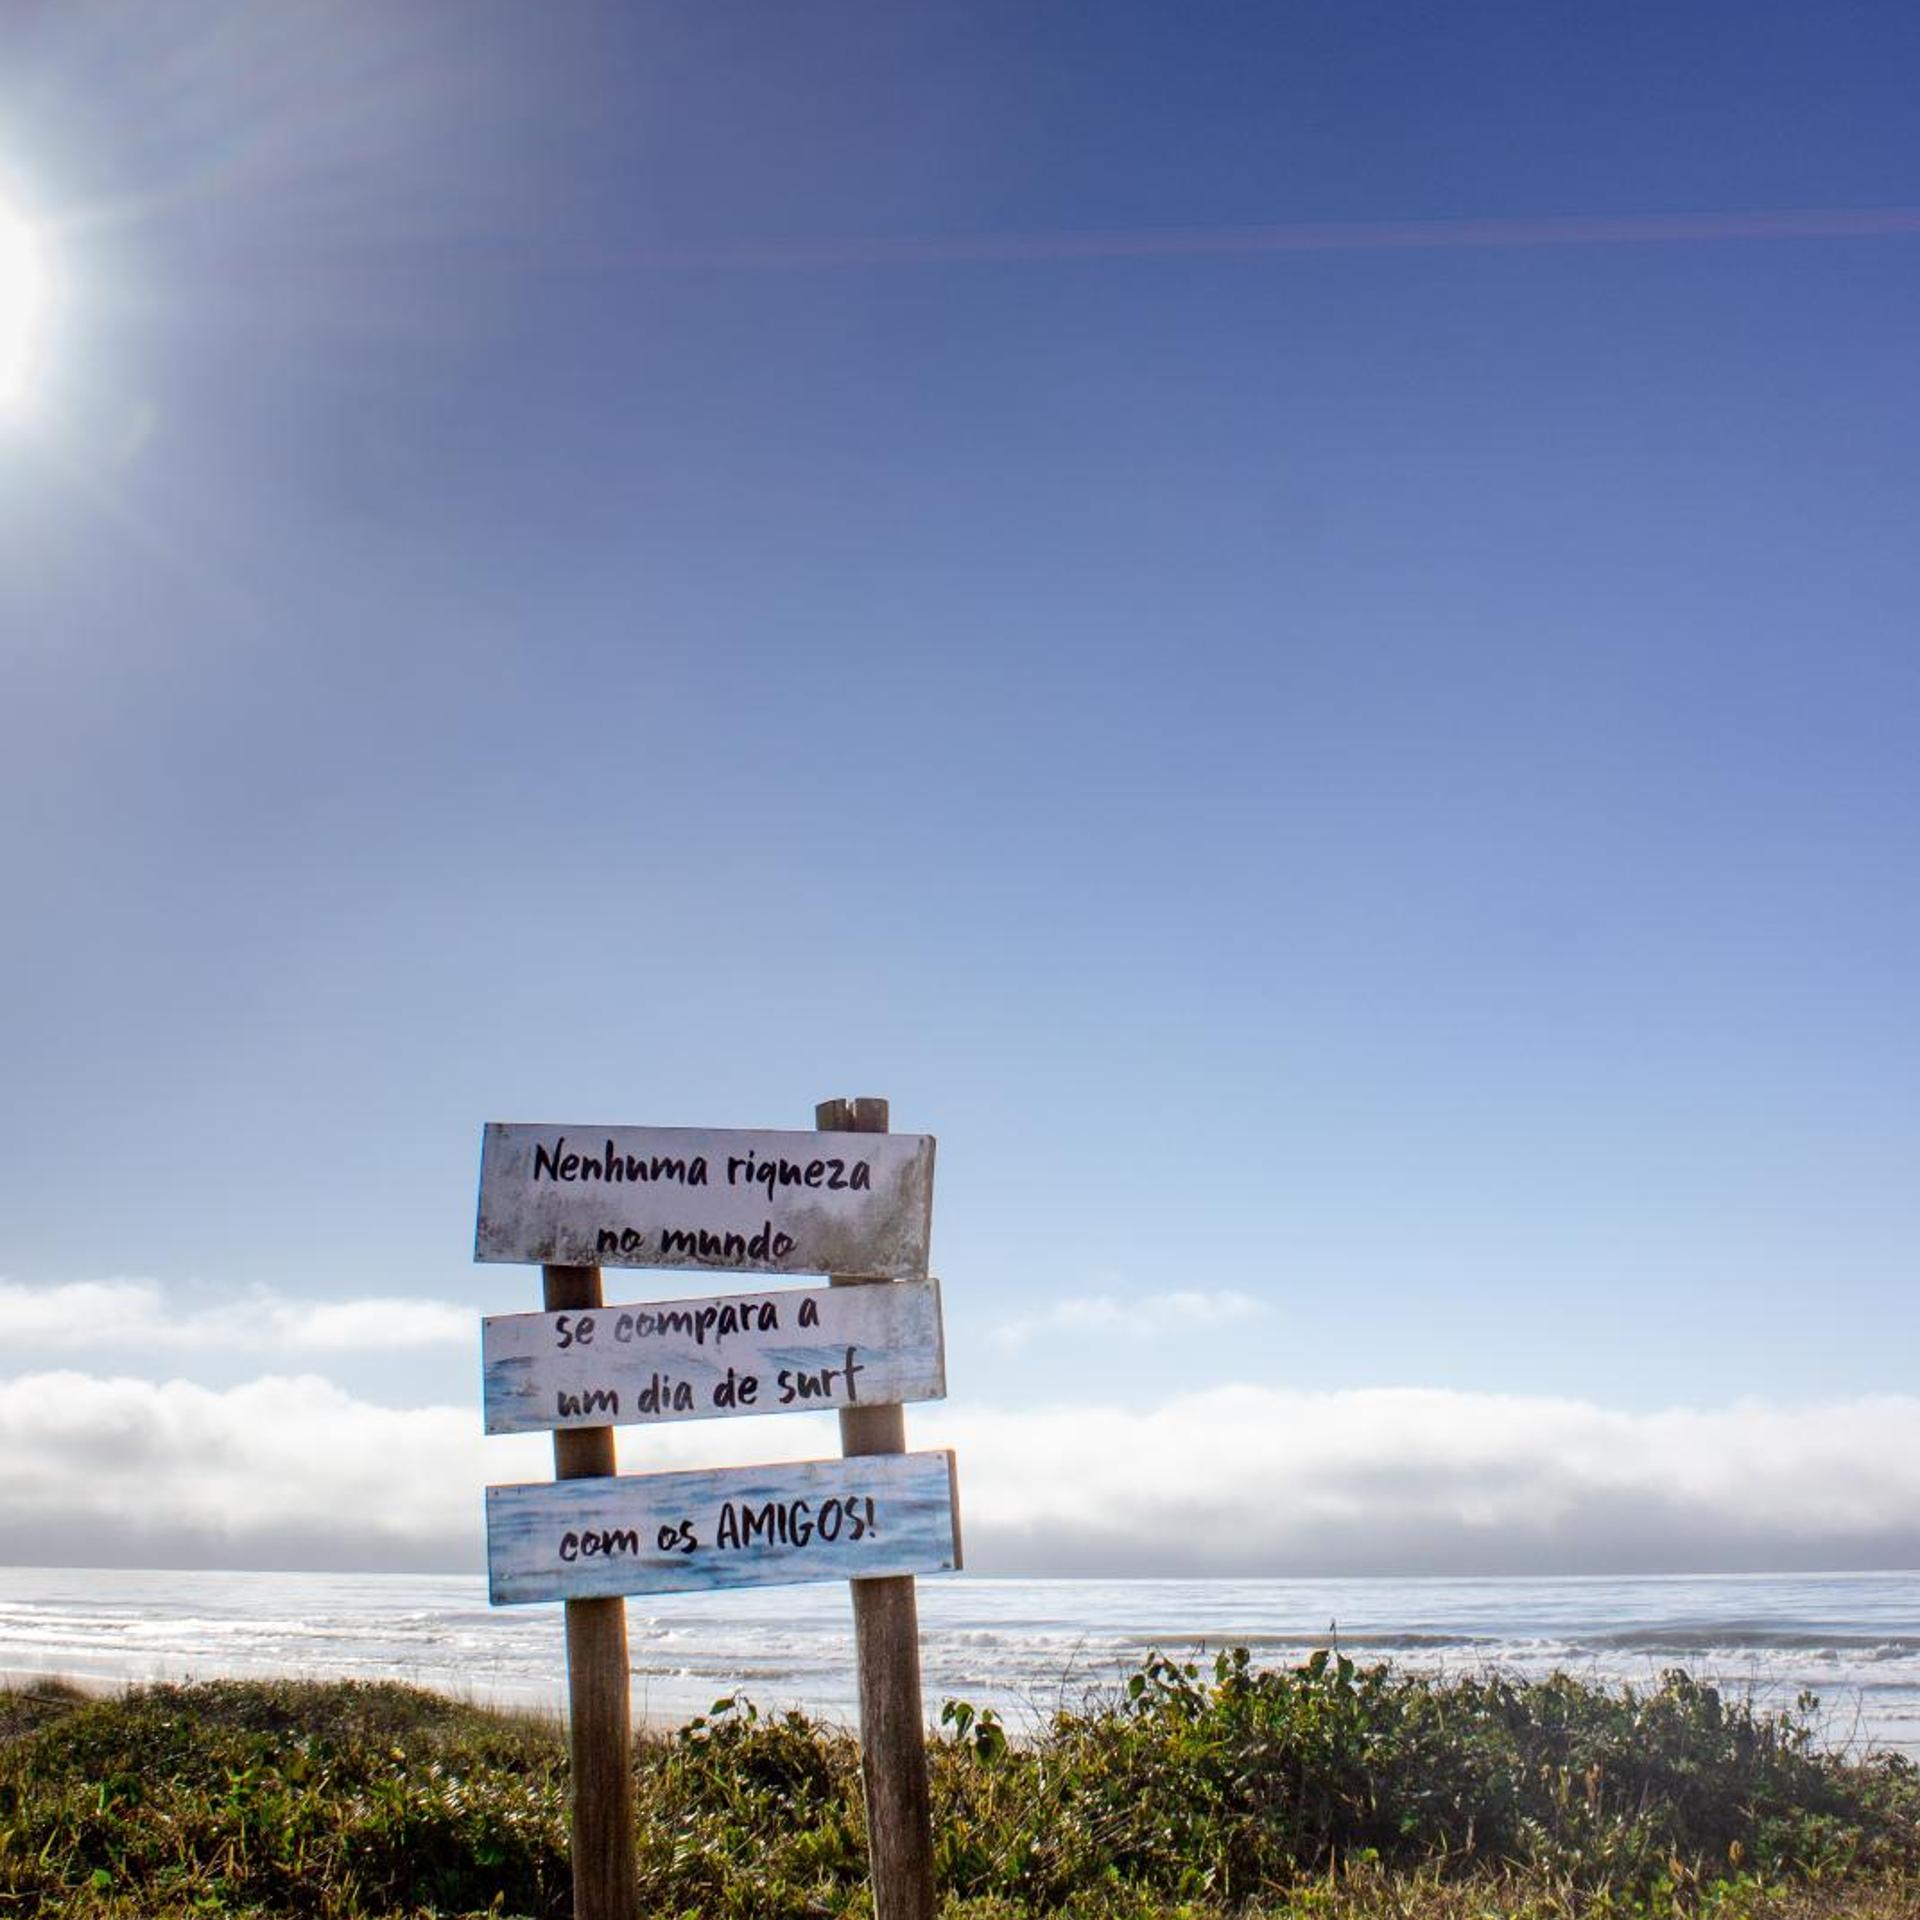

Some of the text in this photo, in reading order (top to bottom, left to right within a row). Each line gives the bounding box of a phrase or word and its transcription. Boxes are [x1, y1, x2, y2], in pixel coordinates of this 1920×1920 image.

[533, 1137, 871, 1201] Nenhuma riqueza
[598, 1220, 798, 1261] no mundo
[555, 1296, 820, 1349] se compara a
[556, 1346, 865, 1418] um dia de surf
[558, 1496, 876, 1562] com os AMIGOS!
